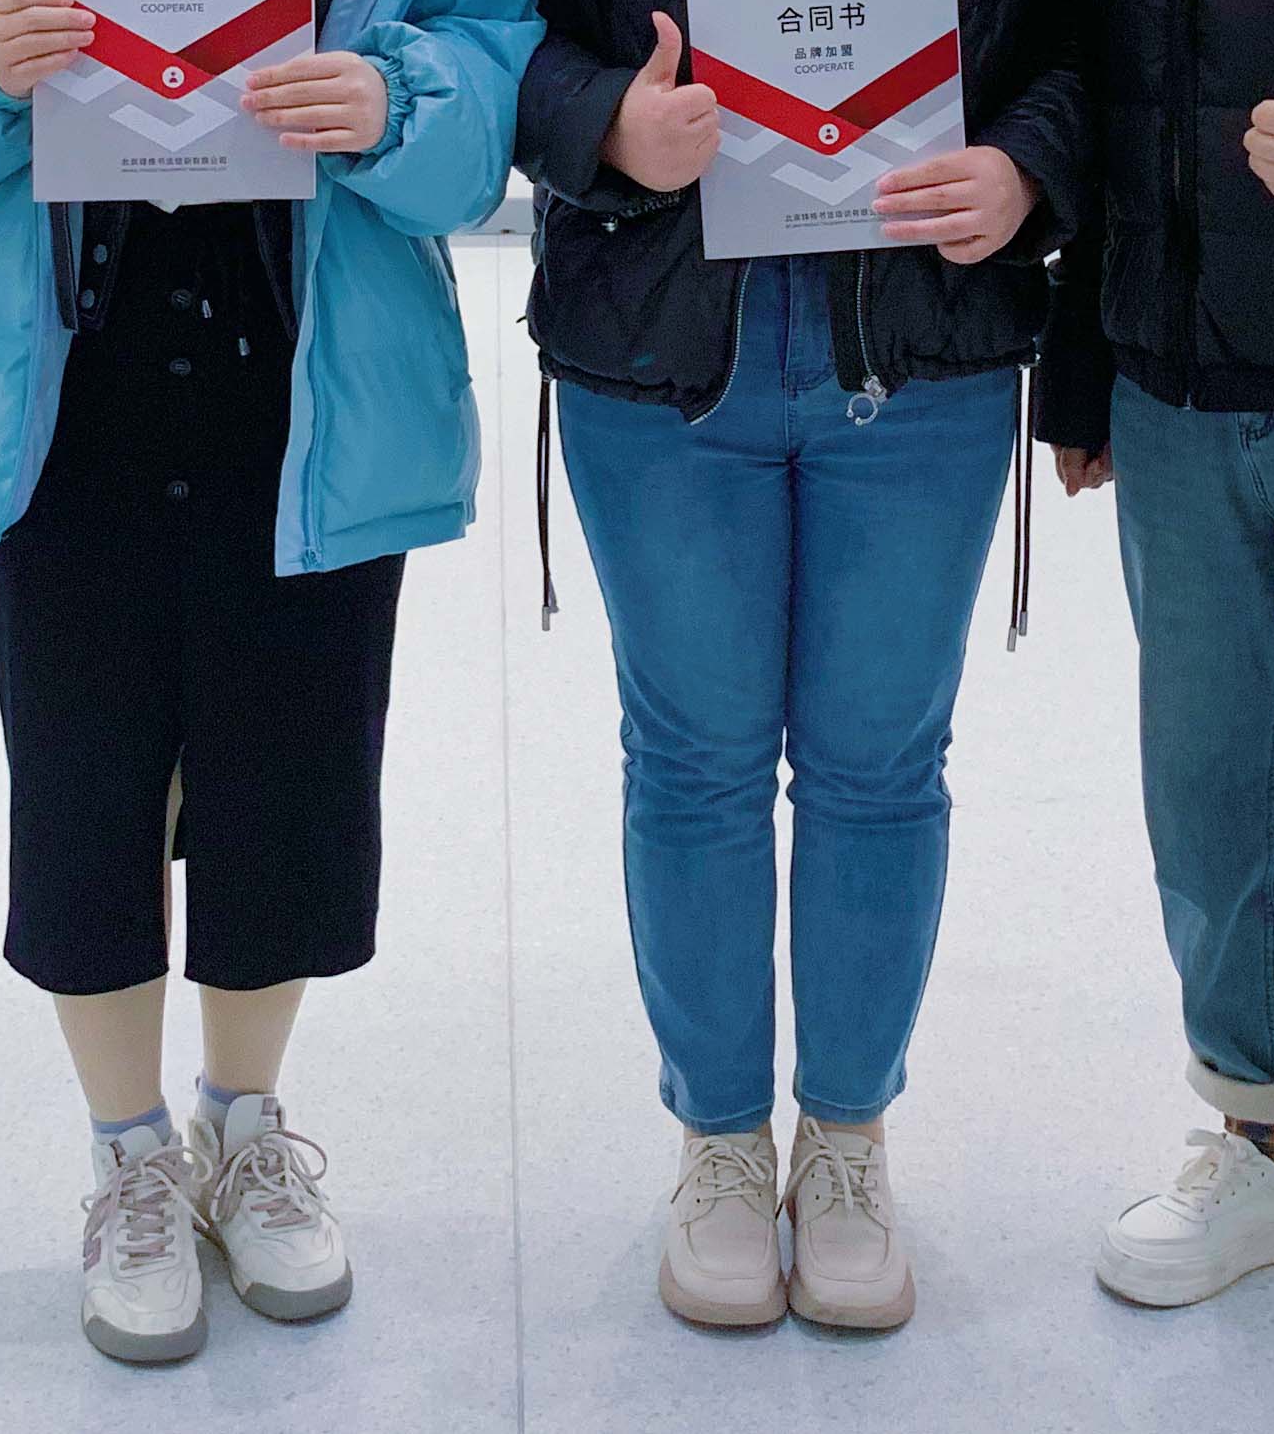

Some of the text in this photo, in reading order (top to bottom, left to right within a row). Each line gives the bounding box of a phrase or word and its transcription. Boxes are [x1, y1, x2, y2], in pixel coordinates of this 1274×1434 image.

[140, 2, 205, 14] COOPERATE
[776, 2, 867, 35] 合同书
[794, 43, 854, 61] 品牌加盟
[794, 60, 855, 76] COOPERATE
